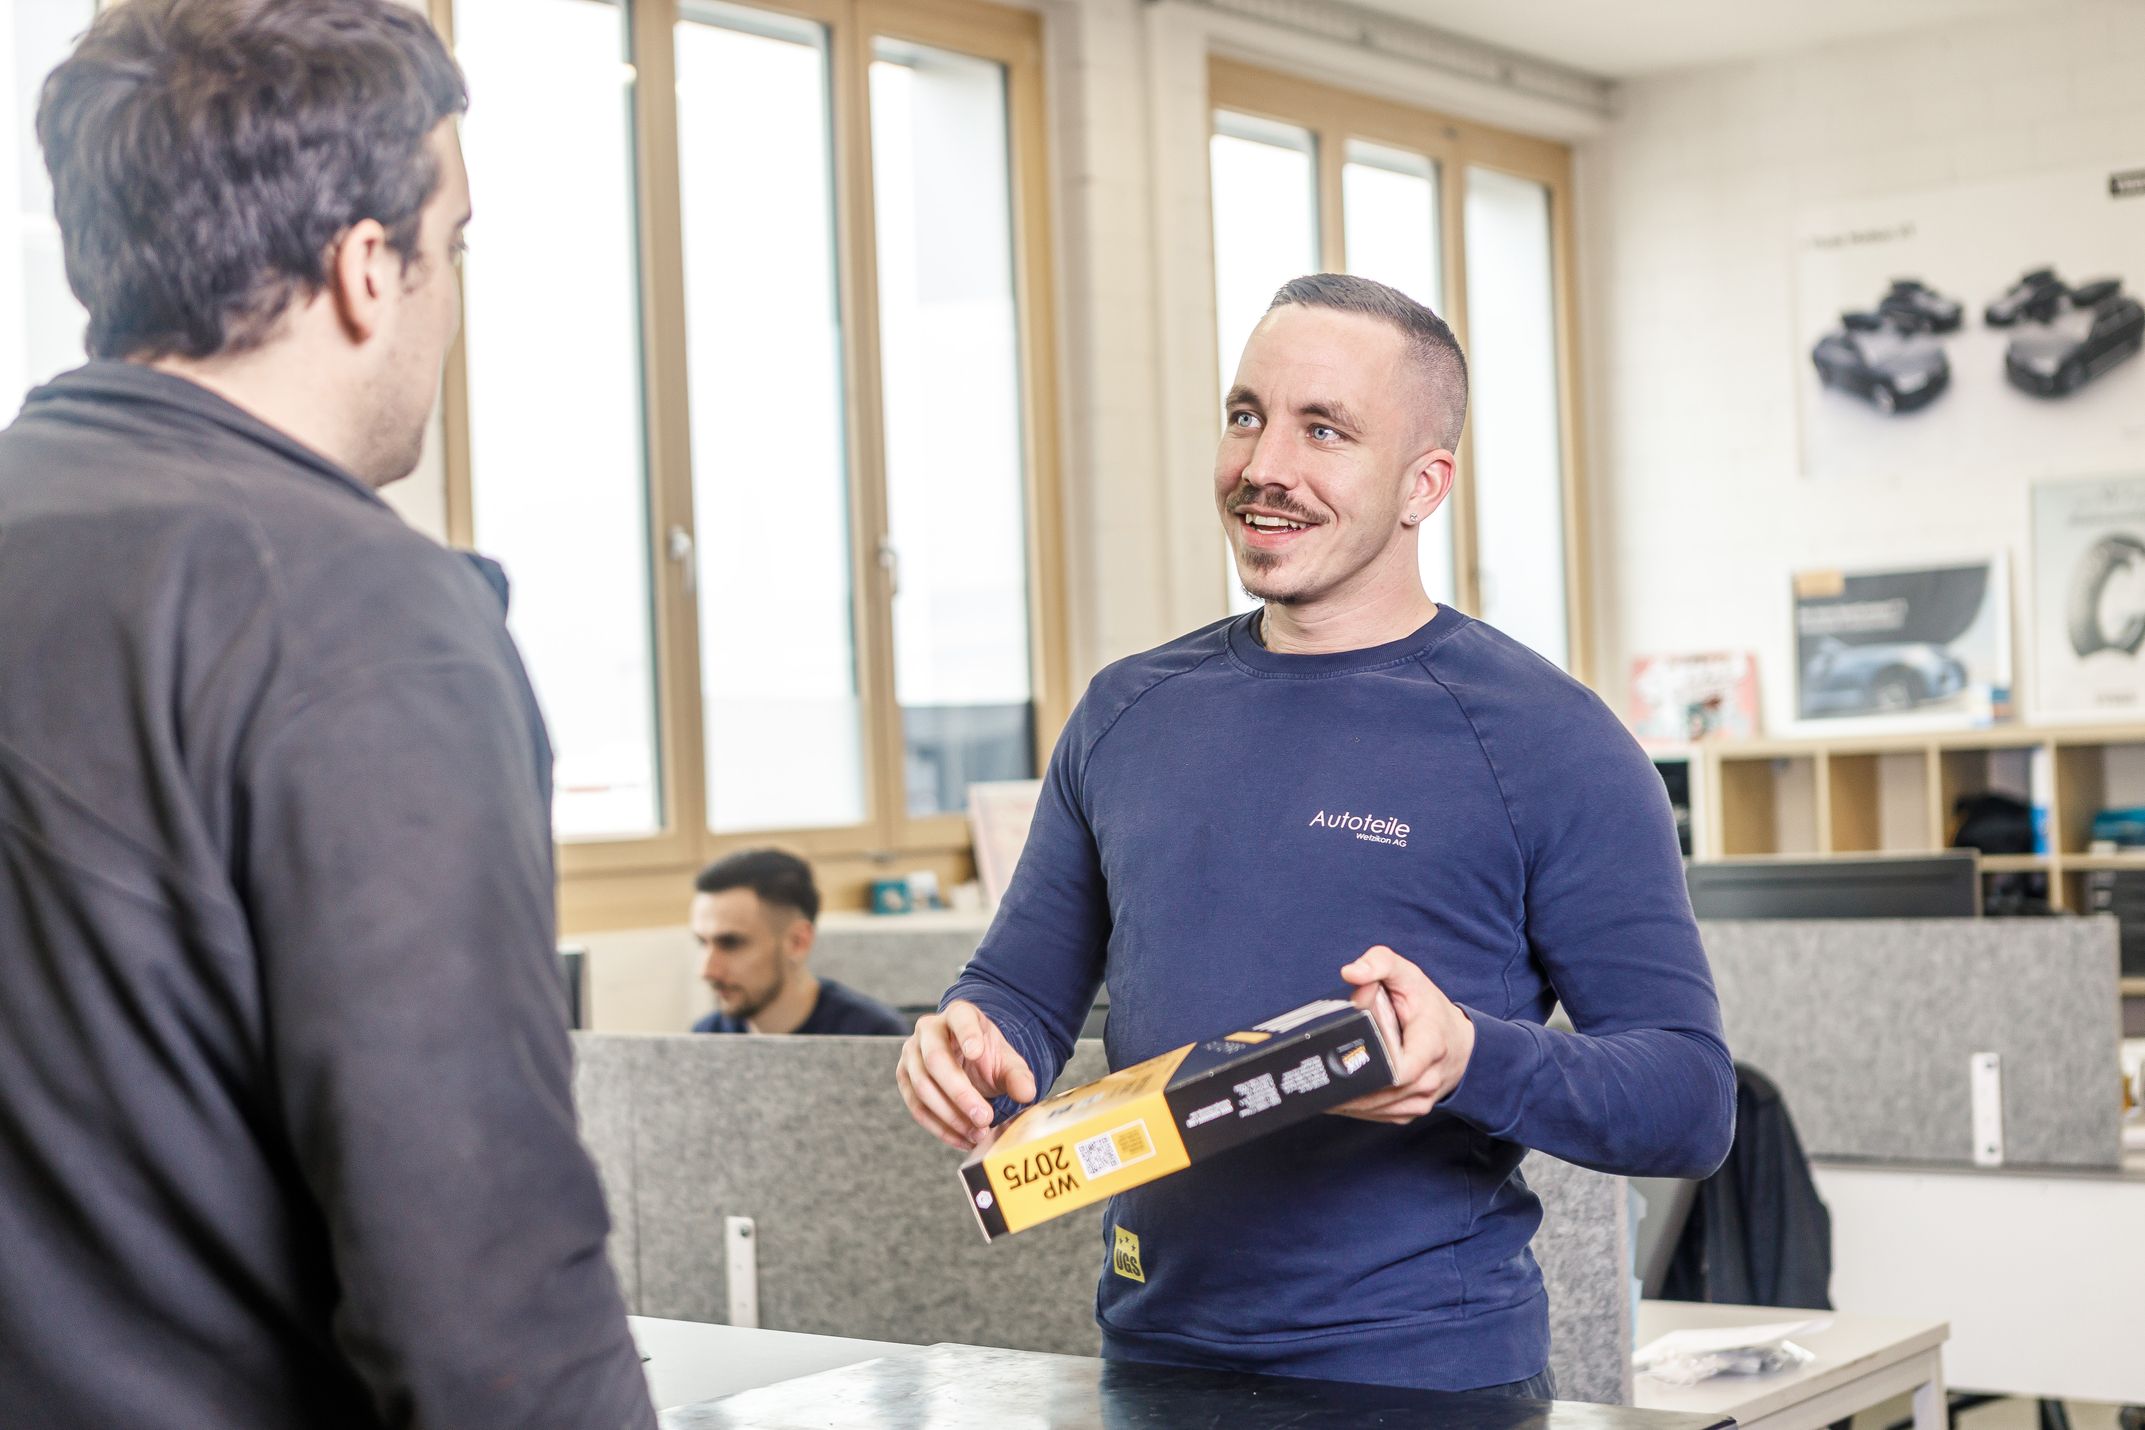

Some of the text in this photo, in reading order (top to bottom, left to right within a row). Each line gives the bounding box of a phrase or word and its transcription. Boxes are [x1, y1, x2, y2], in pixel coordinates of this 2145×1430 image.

[1309, 810, 1411, 838] Autoteile
[1356, 832, 1407, 848] Wetzikon AG
[1003, 1145, 1070, 1190] 2075
[1043, 1173, 1080, 1200] WP
[1116, 1248, 1141, 1276] UGS
